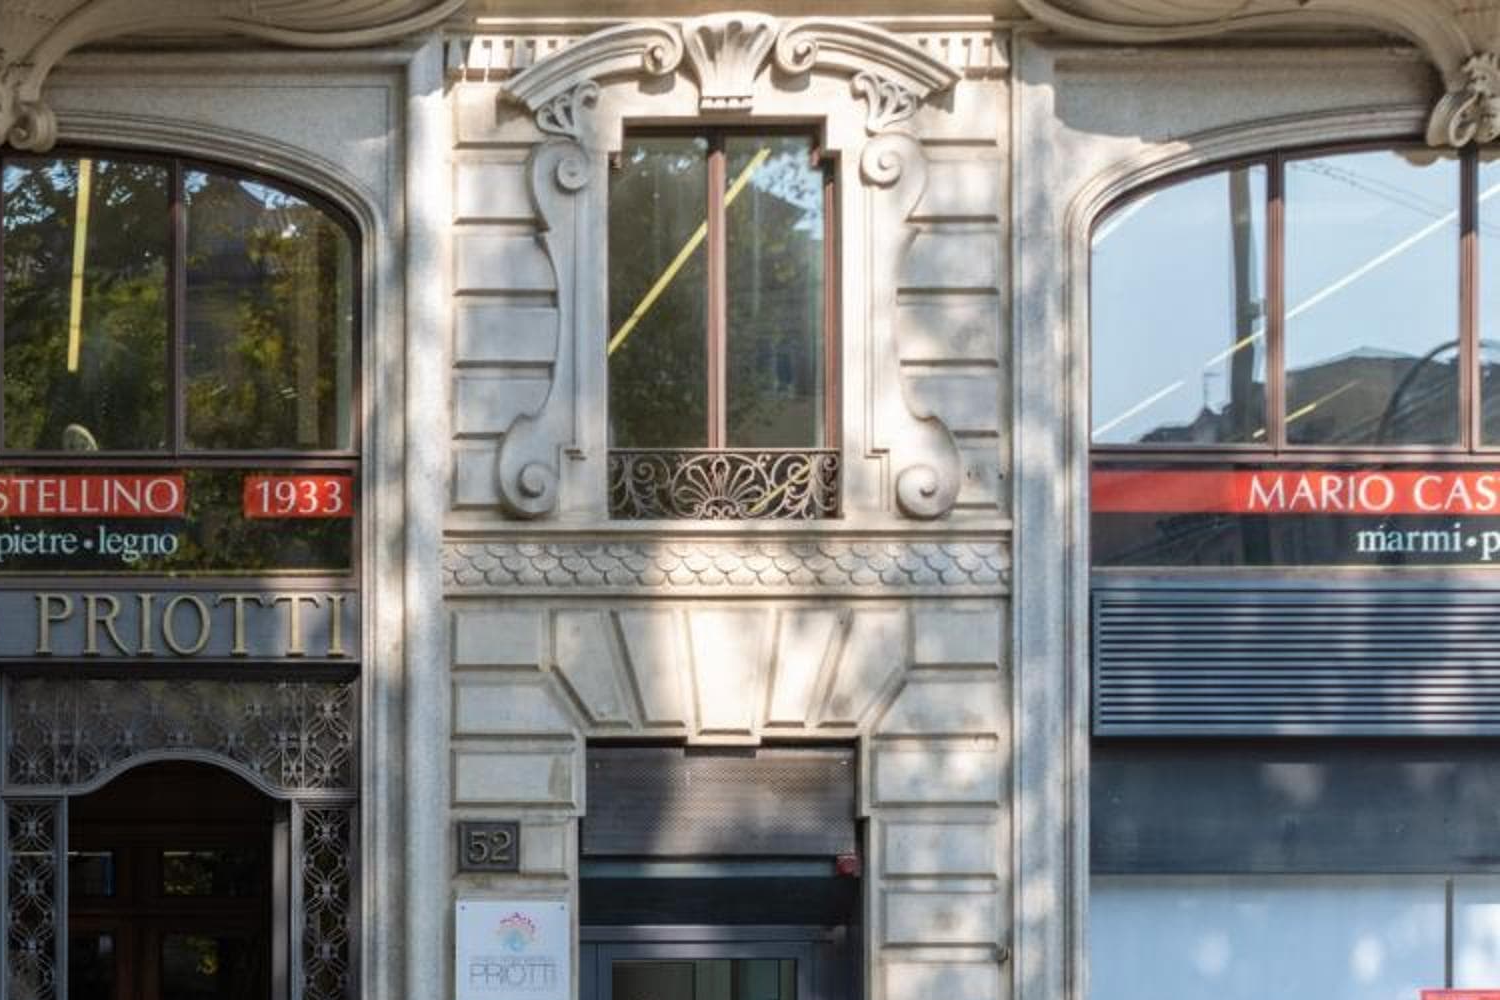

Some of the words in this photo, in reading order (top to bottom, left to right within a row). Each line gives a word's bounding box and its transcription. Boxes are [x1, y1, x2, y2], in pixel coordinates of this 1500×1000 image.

[255, 480, 343, 514] 1933
[1247, 474, 1395, 511] MARIO
[1413, 474, 1500, 511] CAS
[35, 592, 346, 656] PRIOTTI
[469, 830, 512, 864] 52
